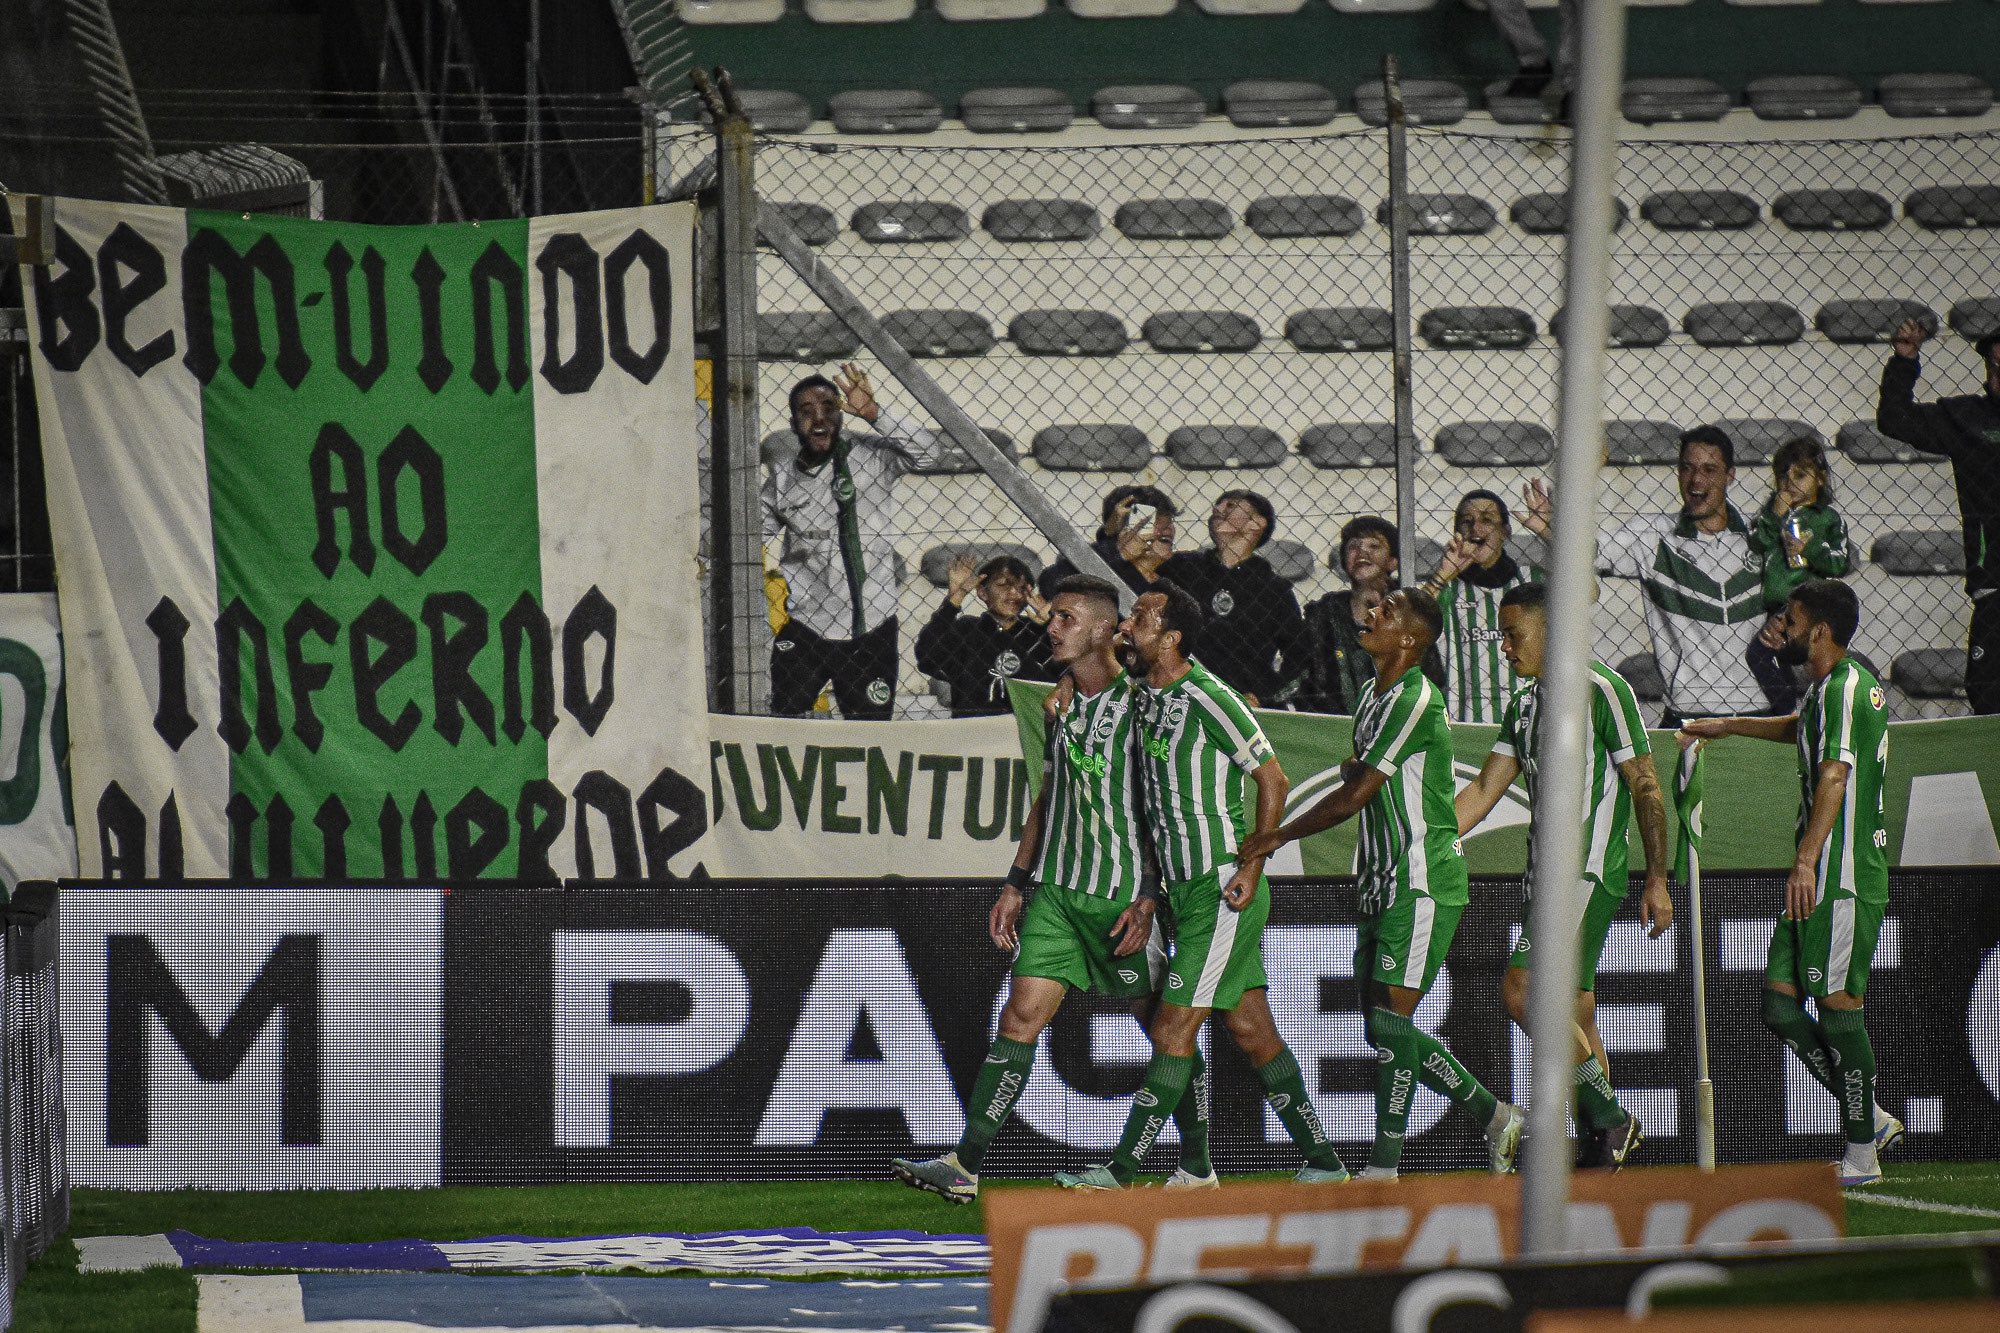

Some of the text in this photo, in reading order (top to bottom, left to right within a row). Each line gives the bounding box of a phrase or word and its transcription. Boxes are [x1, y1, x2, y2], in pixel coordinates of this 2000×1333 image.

[309, 421, 449, 580] AO
[145, 584, 618, 755] INFERNO
[985, 1070, 1022, 1122] PROSOCKS
[1388, 1068, 1413, 1115] PROSOCKS
[1844, 1069, 1864, 1121] PROSOCKS
[1131, 1114, 1164, 1161] PROSOCKS
[1296, 1101, 1327, 1145] PROSOCKS
